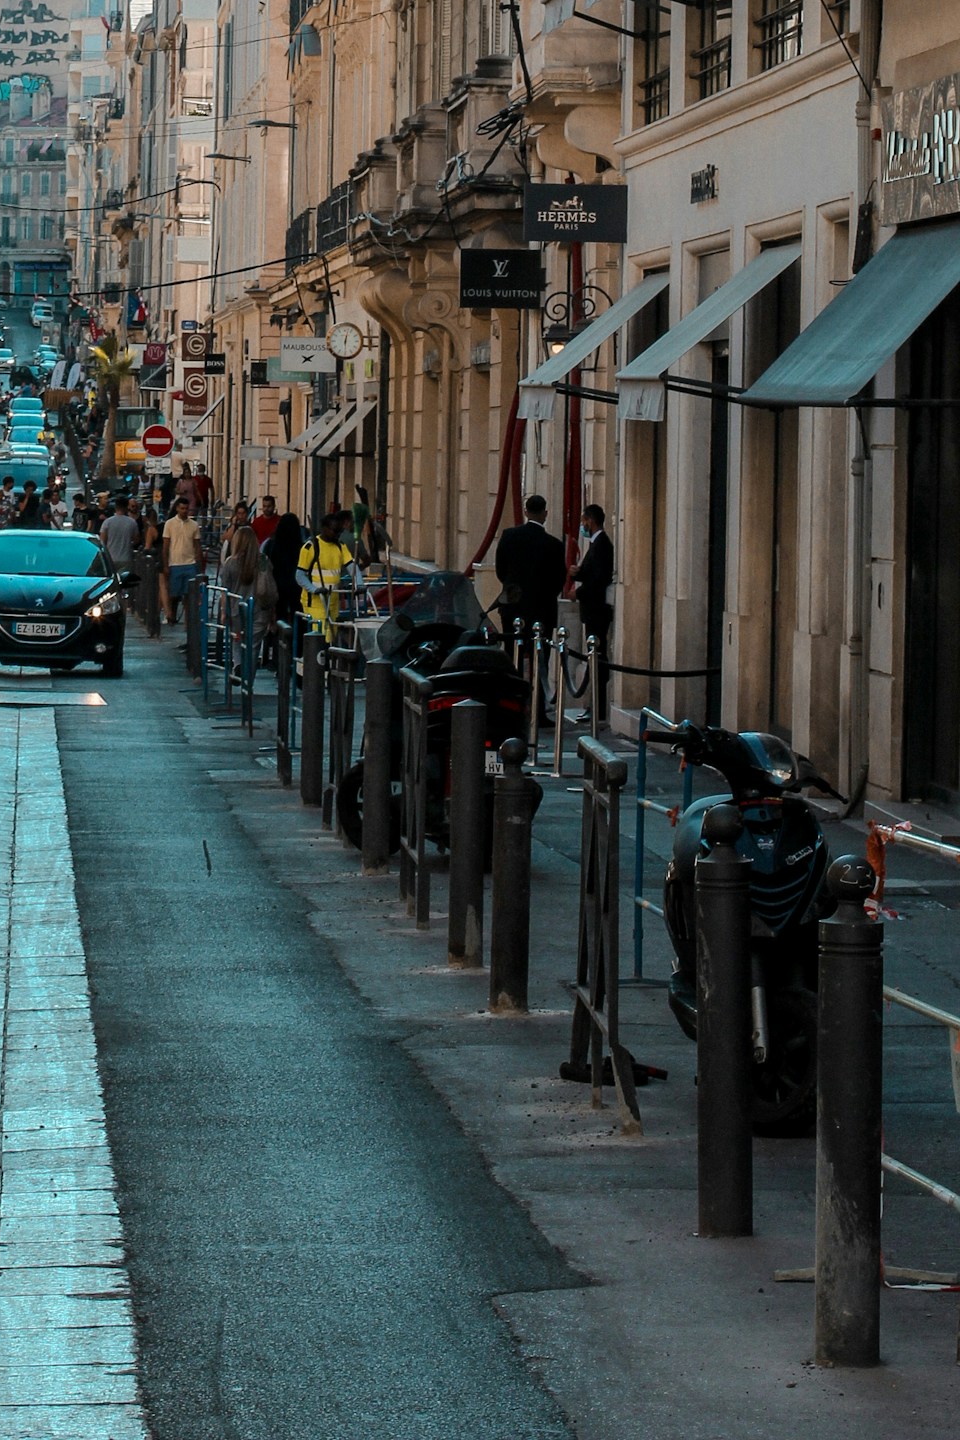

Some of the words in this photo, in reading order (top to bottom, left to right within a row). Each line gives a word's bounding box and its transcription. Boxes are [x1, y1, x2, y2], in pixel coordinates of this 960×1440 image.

[537, 211, 597, 223] HERMÈS
[462, 288, 492, 298] LOUIS
[495, 289, 538, 298] VUITTON
[282, 343, 327, 352] MAUBOUSS
[16, 624, 60, 635] EZ-128-VK
